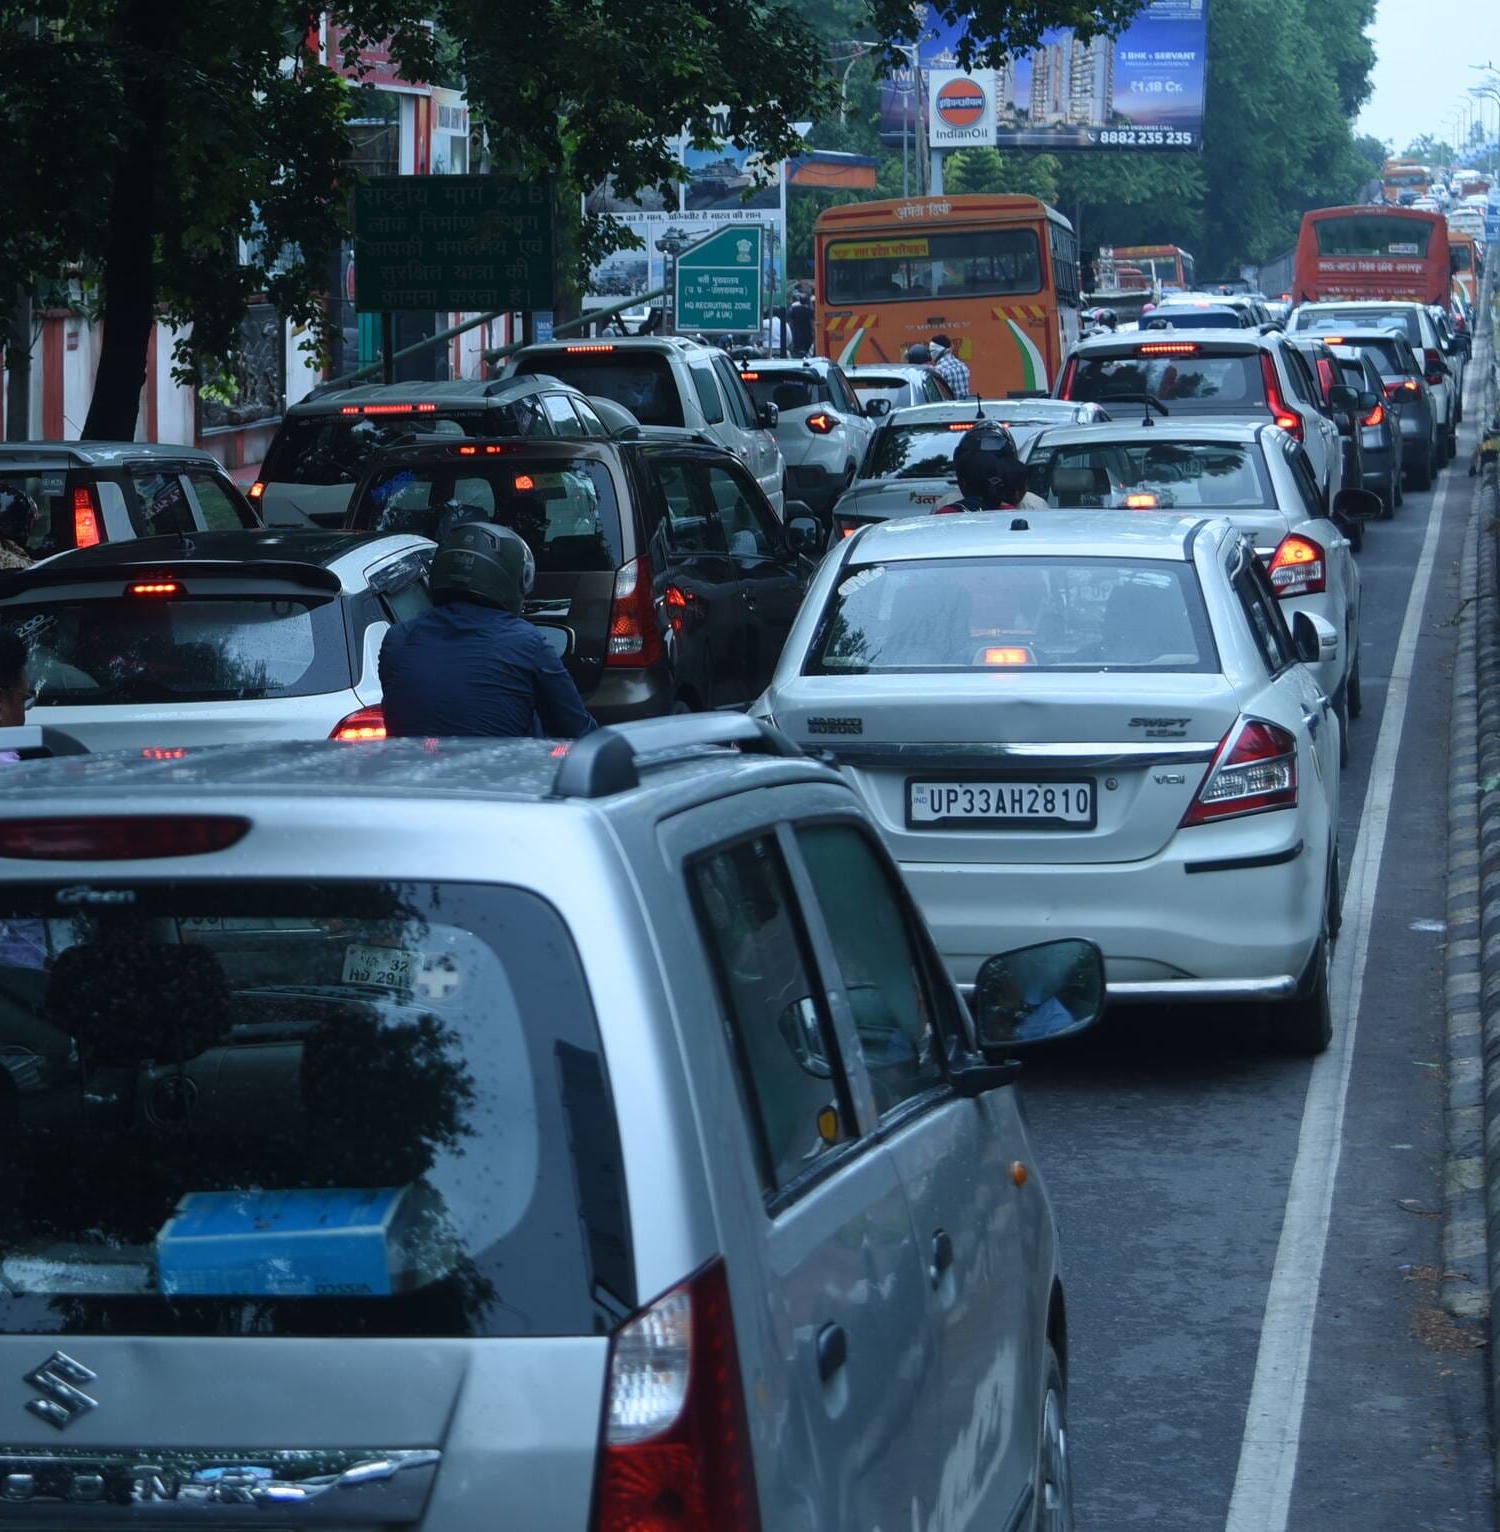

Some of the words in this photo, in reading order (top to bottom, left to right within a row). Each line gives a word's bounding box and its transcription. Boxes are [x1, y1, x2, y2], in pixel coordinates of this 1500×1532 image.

[1128, 52, 1147, 60] BHK
[1154, 52, 1196, 60] SERVANT
[936, 128, 988, 139] IndianOil
[1100, 131, 1136, 144] 8882
[1138, 131, 1164, 144] 235
[1166, 131, 1192, 144] 235
[363, 181, 429, 210] राष्ट्रीय
[442, 182, 484, 205] मार्ग
[368, 211, 408, 232] लोक
[420, 210, 475, 232] निर्माण
[517, 237, 544, 258] एवं
[379, 259, 444, 287] सुरक्षित
[452, 263, 495, 281] यात्रा
[503, 257, 529, 281] की
[381, 287, 437, 305] कामना
[448, 287, 499, 305] करता
[684, 301, 694, 310] HQ
[695, 302, 732, 310] RECRUITING
[734, 302, 752, 310] ZONE
[915, 495, 942, 505] उत्त
[1128, 717, 1192, 728] SWIFT
[929, 788, 1089, 814] UP33AH2810
